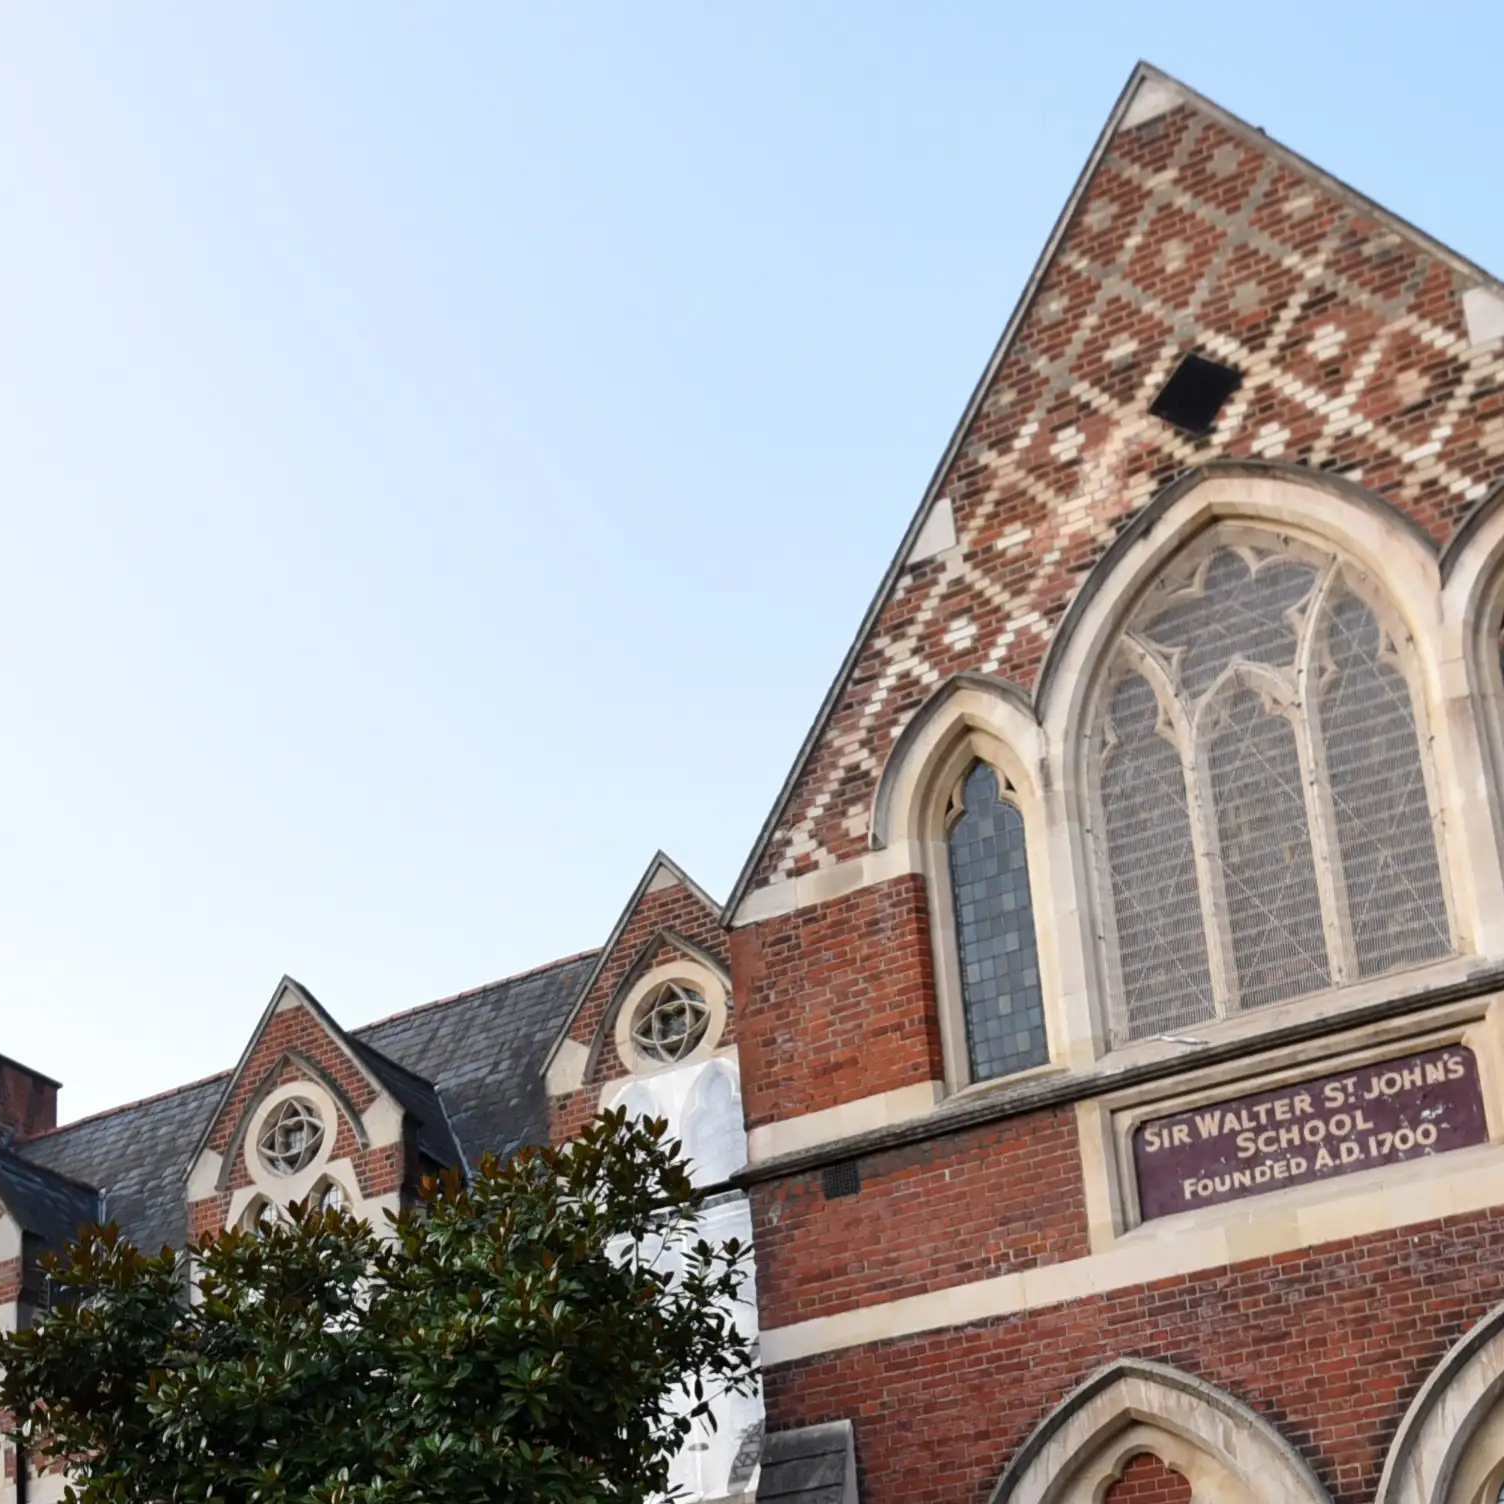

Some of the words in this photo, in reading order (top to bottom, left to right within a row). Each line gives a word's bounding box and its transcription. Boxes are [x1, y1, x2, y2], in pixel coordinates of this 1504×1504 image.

[1144, 1124, 1193, 1152] SIR
[1195, 1094, 1315, 1140] WALTER
[1363, 1053, 1465, 1100] JOHN'S
[1236, 1109, 1374, 1158] SCHOOL
[1183, 1157, 1308, 1200] FOUNDED
[1368, 1123, 1438, 1157] 1700
